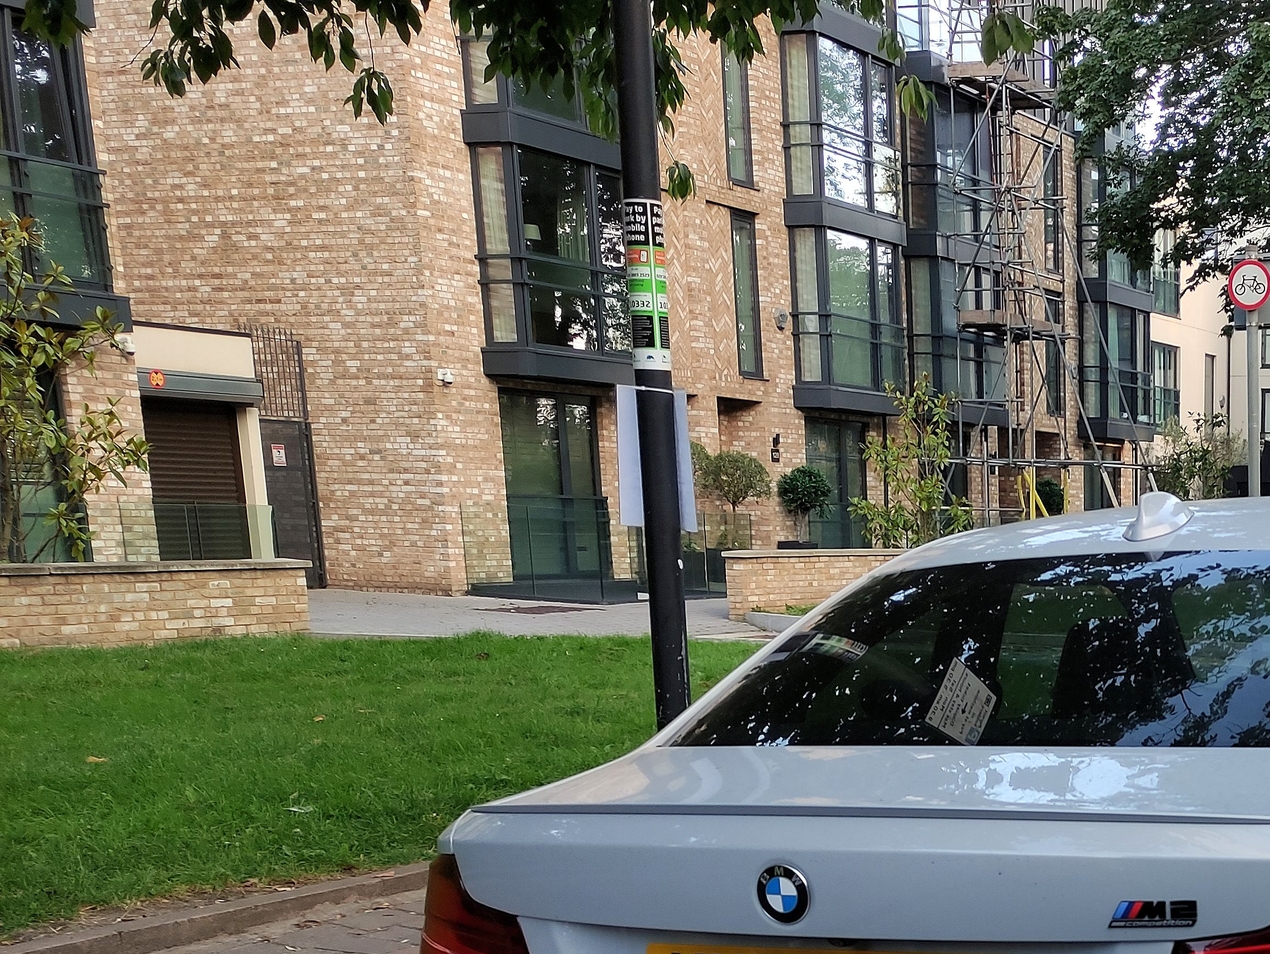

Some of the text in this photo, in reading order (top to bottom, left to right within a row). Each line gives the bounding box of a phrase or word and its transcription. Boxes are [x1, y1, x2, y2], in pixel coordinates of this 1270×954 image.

[634, 205, 644, 213] to
[635, 214, 646, 224] by
[760, 866, 802, 885] BMW
[1130, 900, 1198, 920] M2
[1125, 919, 1193, 928] competition
